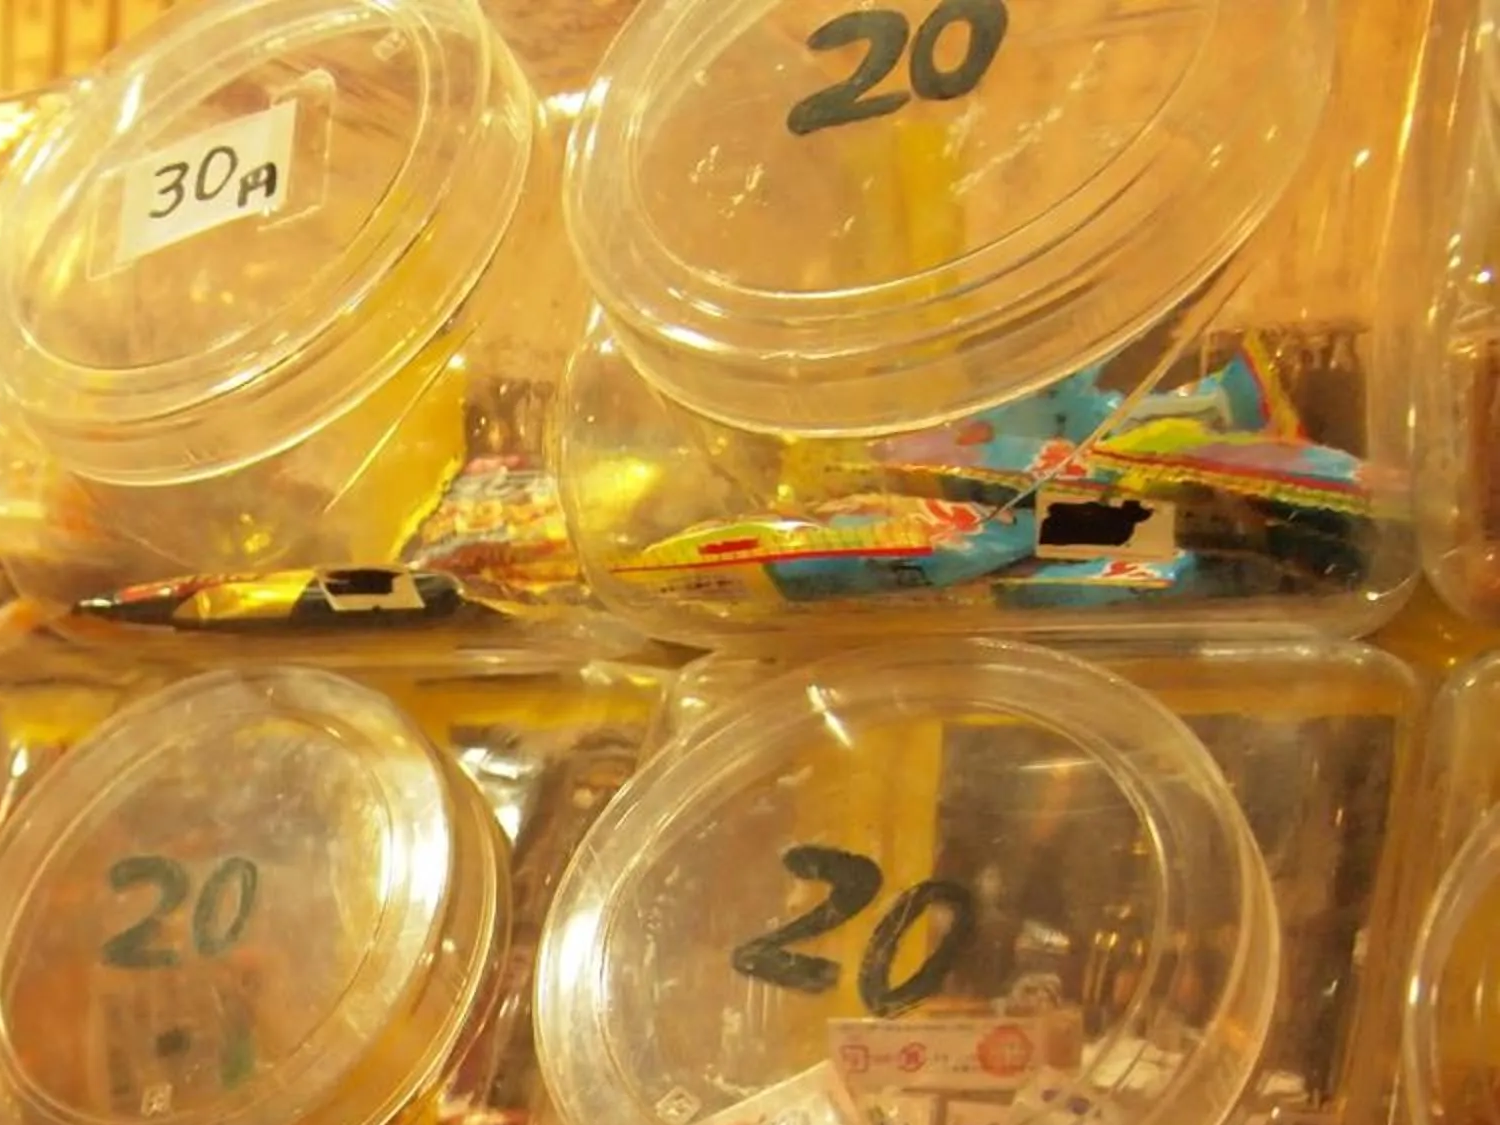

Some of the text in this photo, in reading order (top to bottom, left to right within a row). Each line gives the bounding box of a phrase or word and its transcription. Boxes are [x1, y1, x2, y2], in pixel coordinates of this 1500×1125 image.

[786, 0, 1008, 136] 20
[102, 854, 259, 971] 20
[734, 844, 975, 1018] 20
